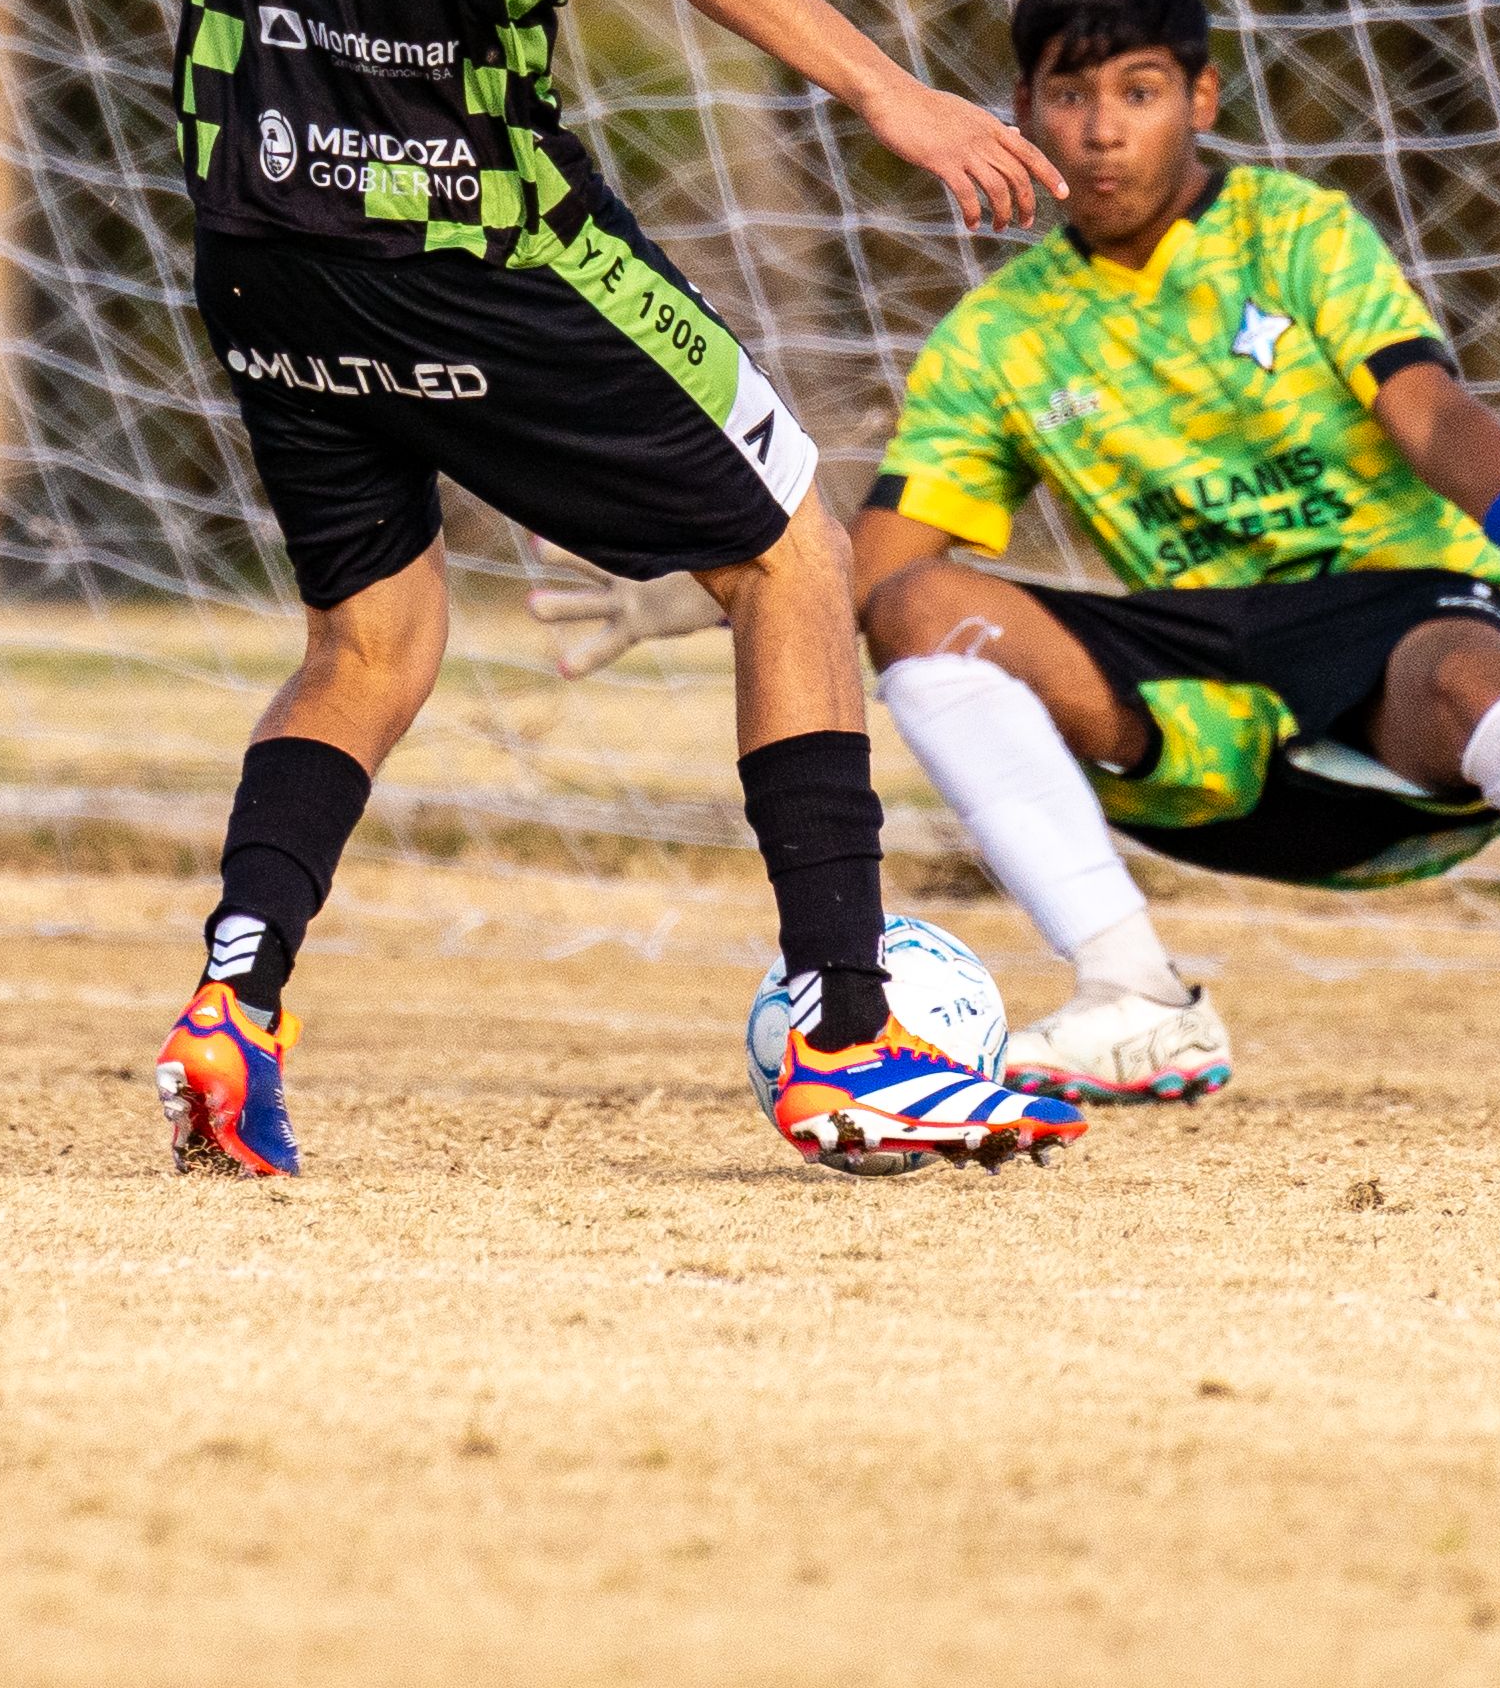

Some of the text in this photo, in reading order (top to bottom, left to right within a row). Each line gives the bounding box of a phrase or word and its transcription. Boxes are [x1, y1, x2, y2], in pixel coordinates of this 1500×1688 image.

[306, 18, 460, 67] Montemar
[307, 123, 477, 167] MENDOZA
[308, 161, 480, 202] GOBIERNO
[639, 290, 707, 366] 1908
[250, 347, 488, 400] MULTILED
